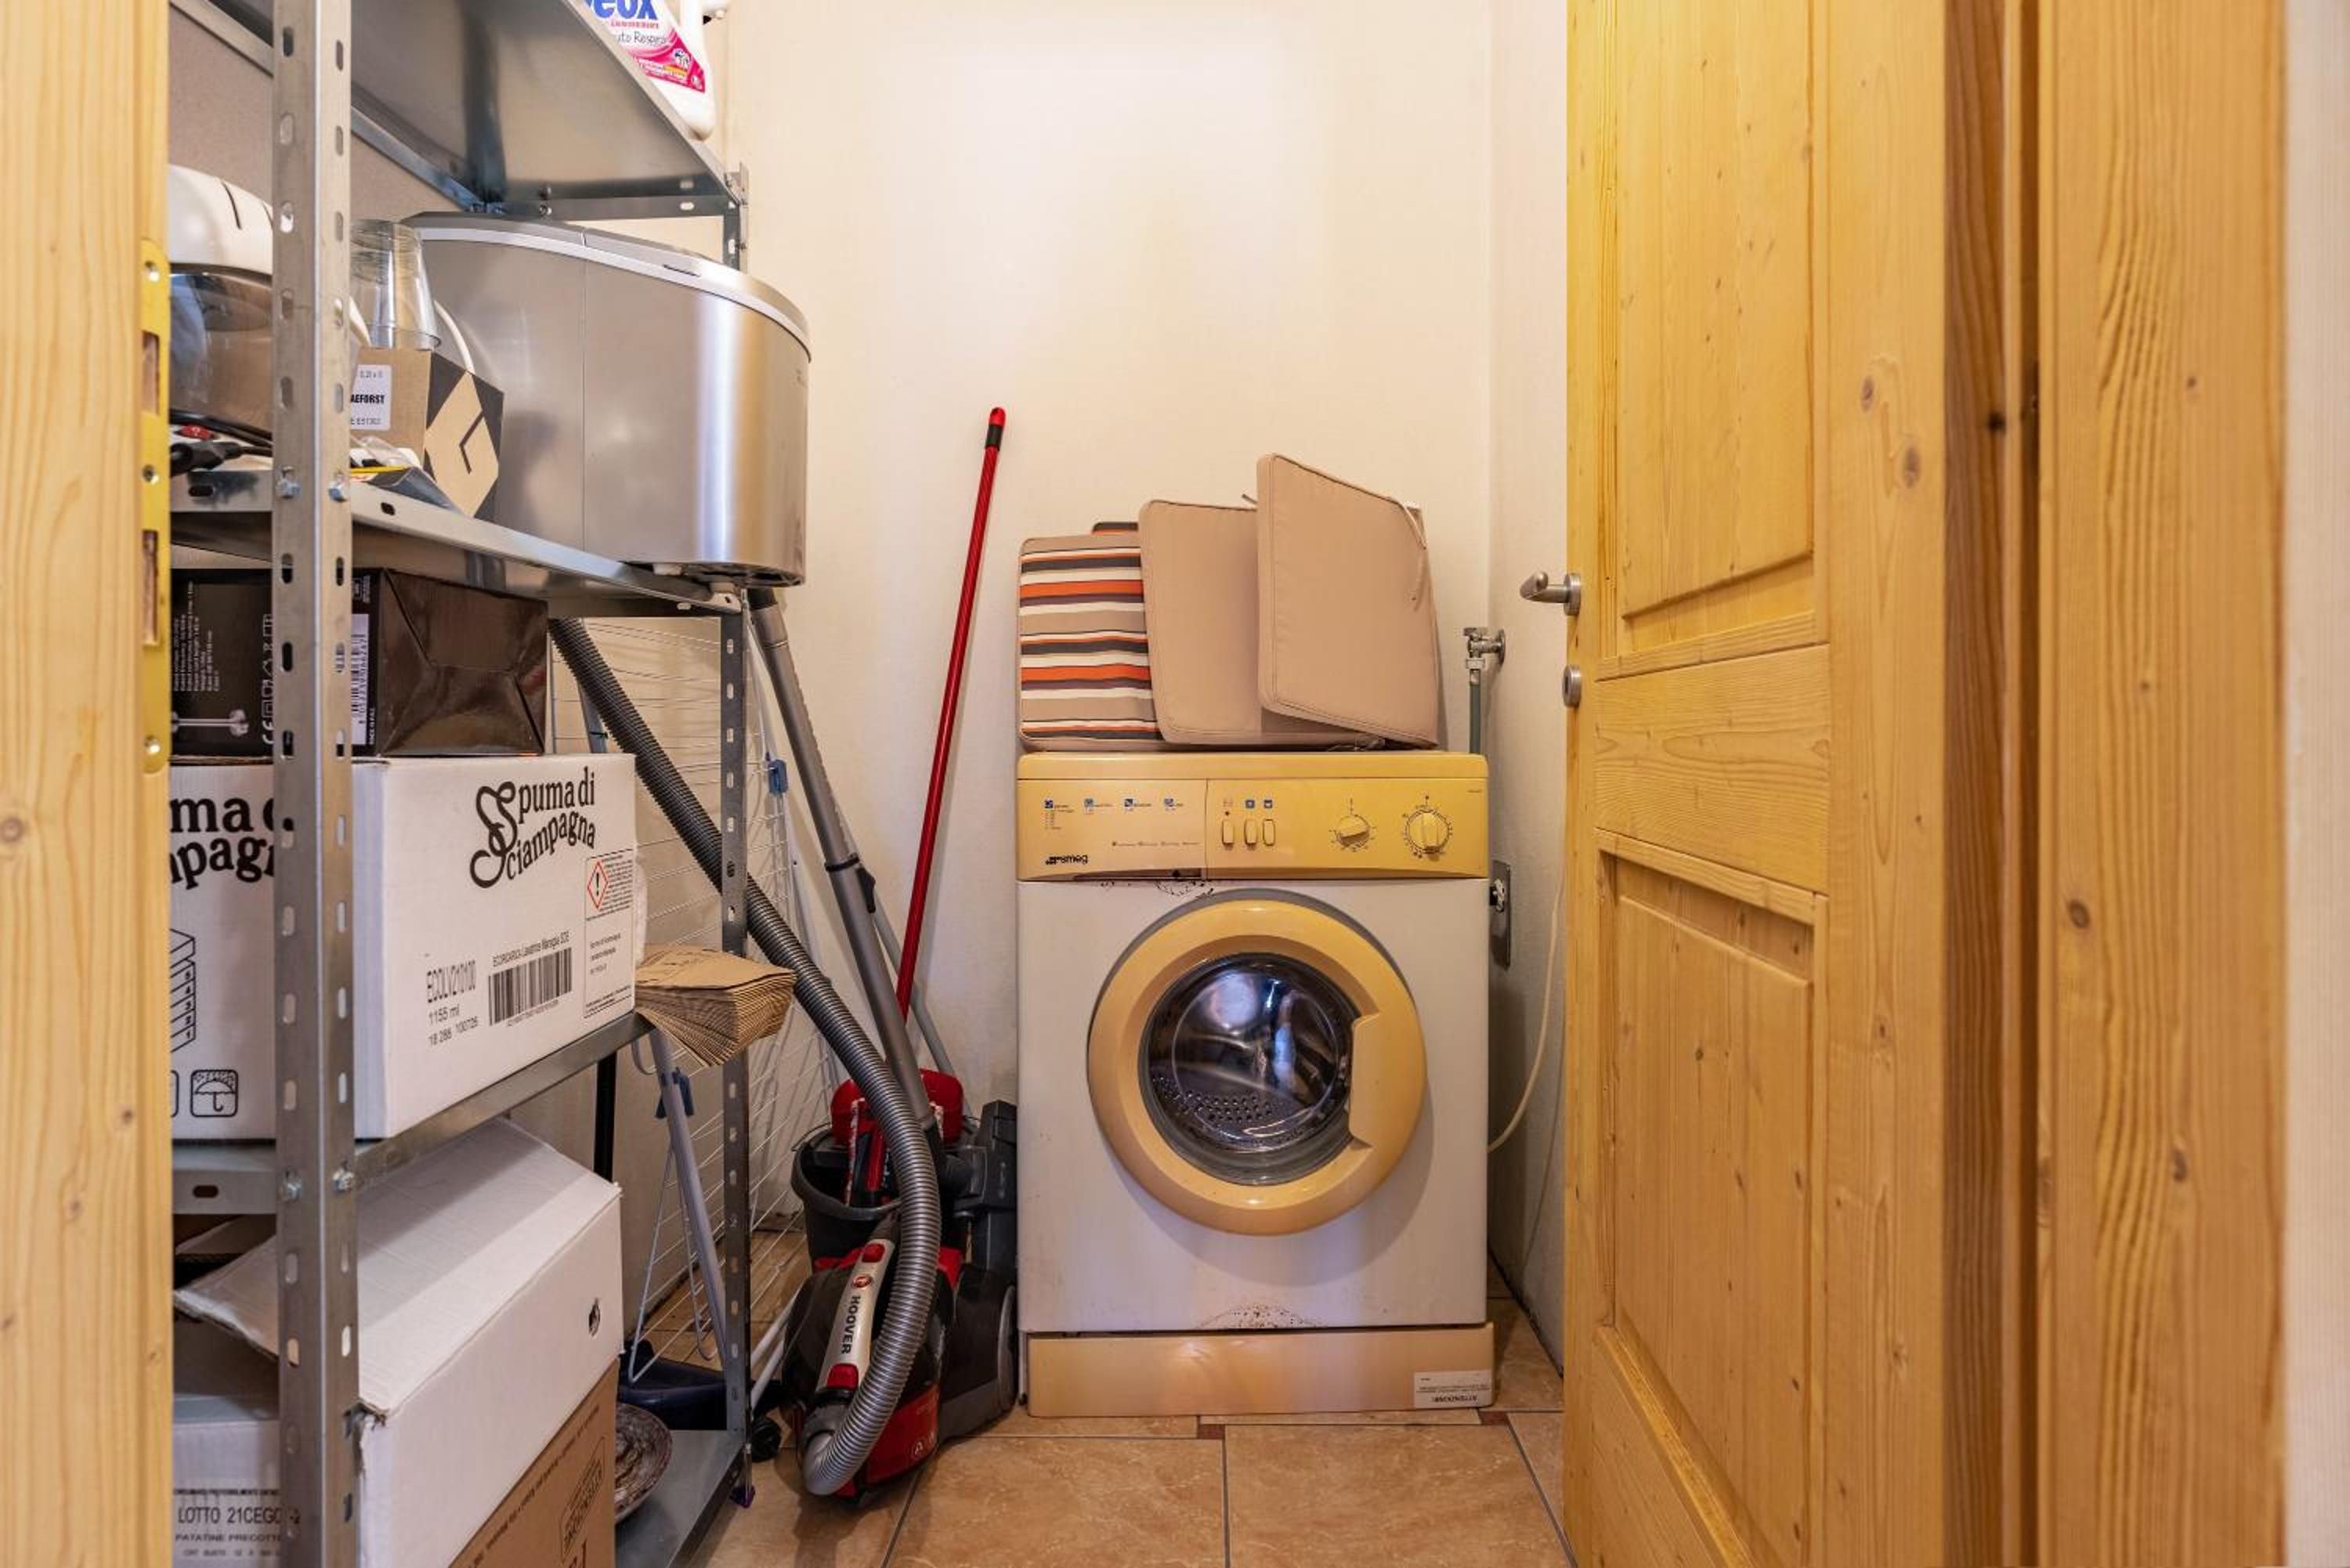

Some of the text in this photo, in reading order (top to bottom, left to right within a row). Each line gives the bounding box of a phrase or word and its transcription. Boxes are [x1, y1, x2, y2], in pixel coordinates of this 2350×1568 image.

[585, 0, 658, 20] eox
[475, 766, 595, 858] Spuma di
[470, 811, 595, 888] Sciampagna
[429, 1006, 447, 1026] 1155
[841, 1295, 861, 1354] HOOVER
[178, 1506, 220, 1523] LOTTO
[175, 1533, 224, 1541] PATATINE
